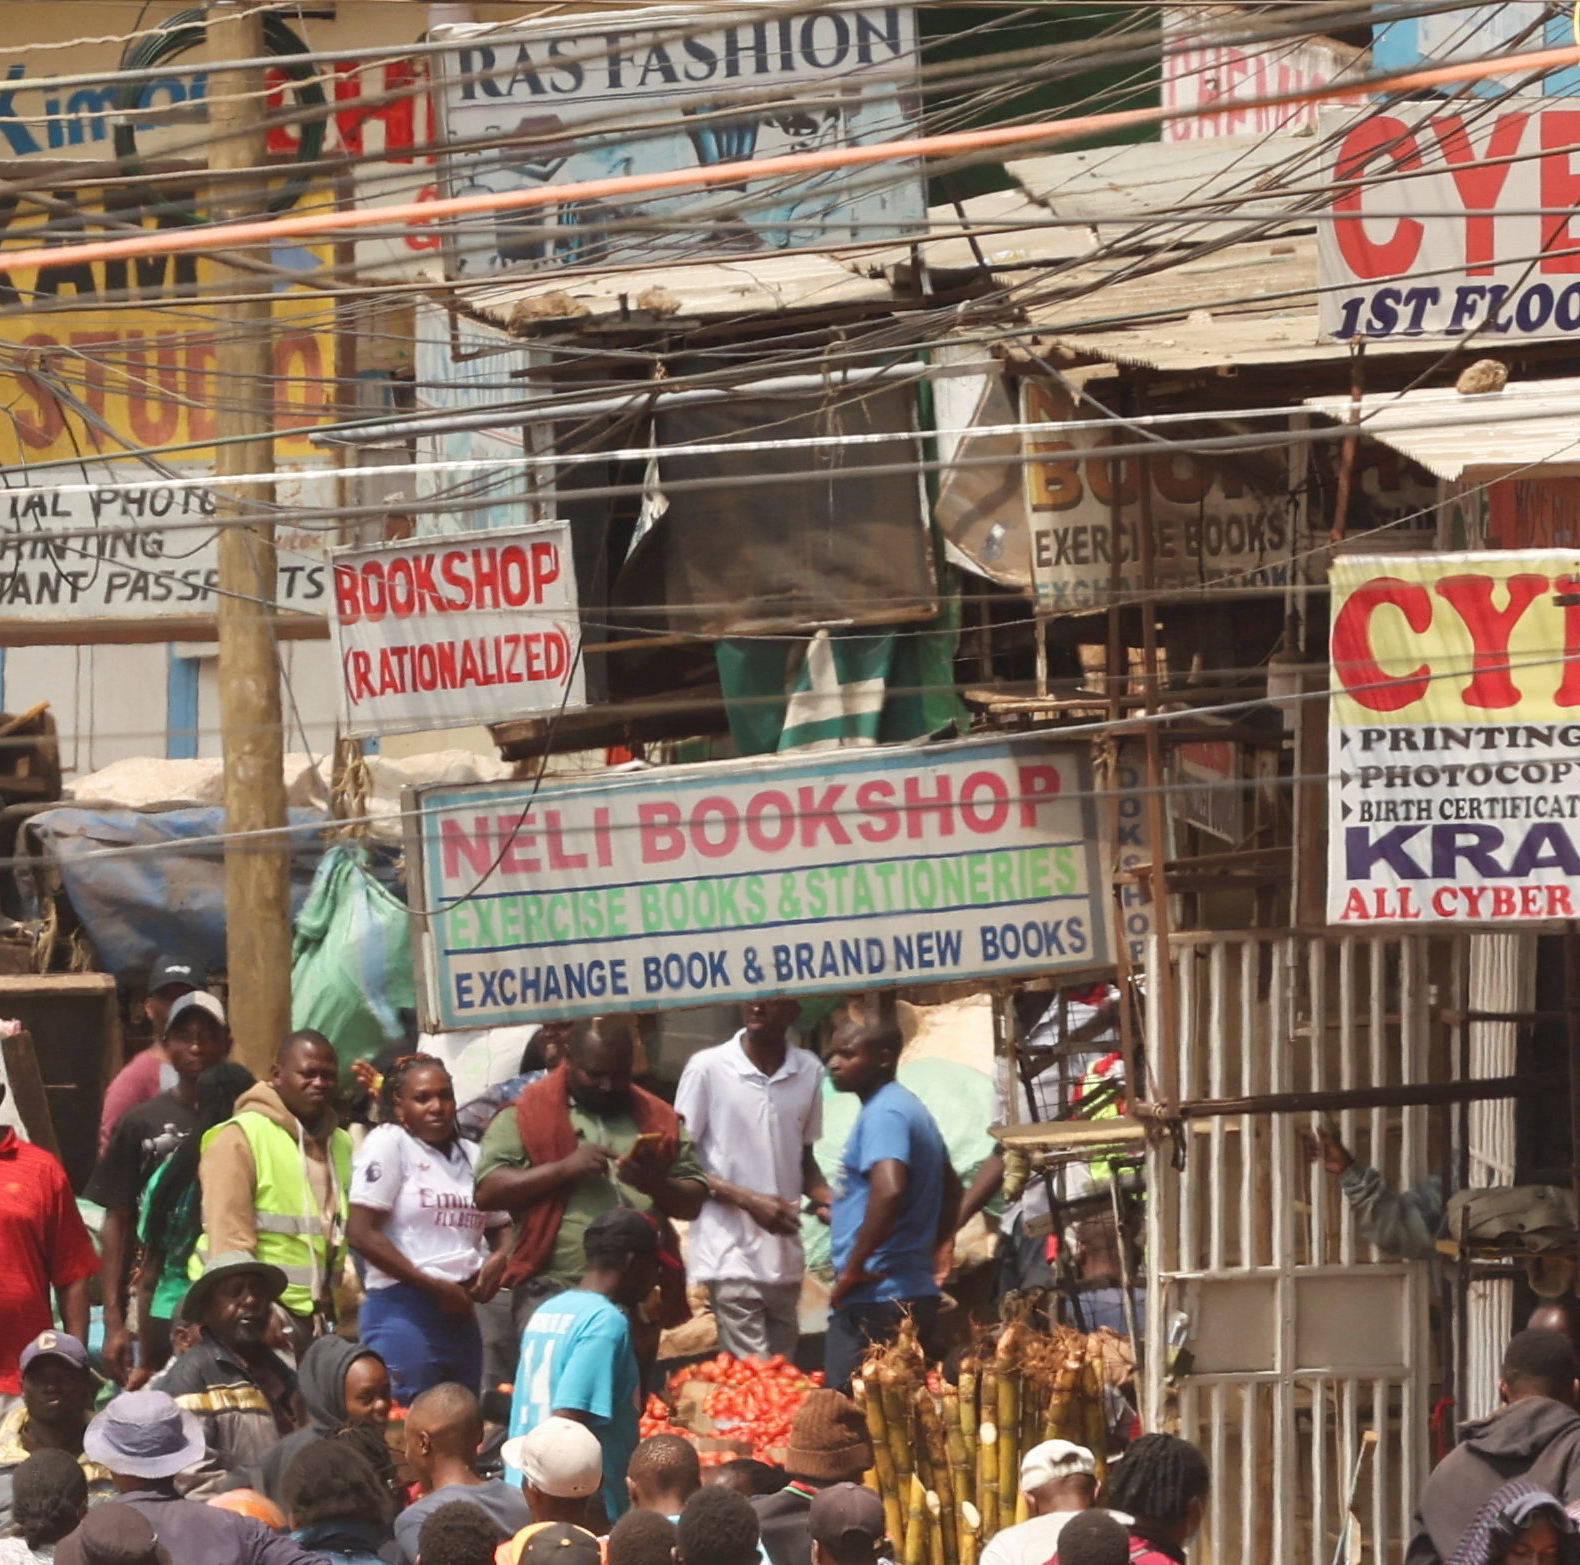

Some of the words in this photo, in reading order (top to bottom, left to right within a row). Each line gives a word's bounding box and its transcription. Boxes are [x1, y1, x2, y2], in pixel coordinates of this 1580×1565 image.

[459, 38, 583, 100] RAS
[603, 9, 902, 89] FASHION
[1335, 285, 1439, 338] 1ST
[17, 330, 324, 444] STUDO
[1035, 524, 1177, 570] EXERCIE
[1185, 512, 1288, 557] BOOKS
[336, 541, 561, 625] BOOKSHOP
[343, 623, 573, 704] (RATIONALIZED)
[1359, 725, 1580, 752] PRINTING
[441, 806, 612, 880] NELI
[640, 764, 1063, 866] BOOKSHOP
[1359, 797, 1433, 822] BIRTH
[1439, 793, 1580, 821] CERTIFICAT
[1345, 822, 1580, 881] KRA
[449, 885, 627, 951] EXERCISE
[643, 869, 766, 933] BOOKS
[1341, 886, 1422, 920] ALL
[1432, 883, 1575, 919] CYBER
[456, 957, 630, 1011] EXCHANGE
[643, 945, 729, 994] BOOK
[742, 944, 765, 984] &
[774, 936, 886, 985] BRAND
[894, 928, 964, 973] NEW
[980, 915, 1088, 961] BOOKS
